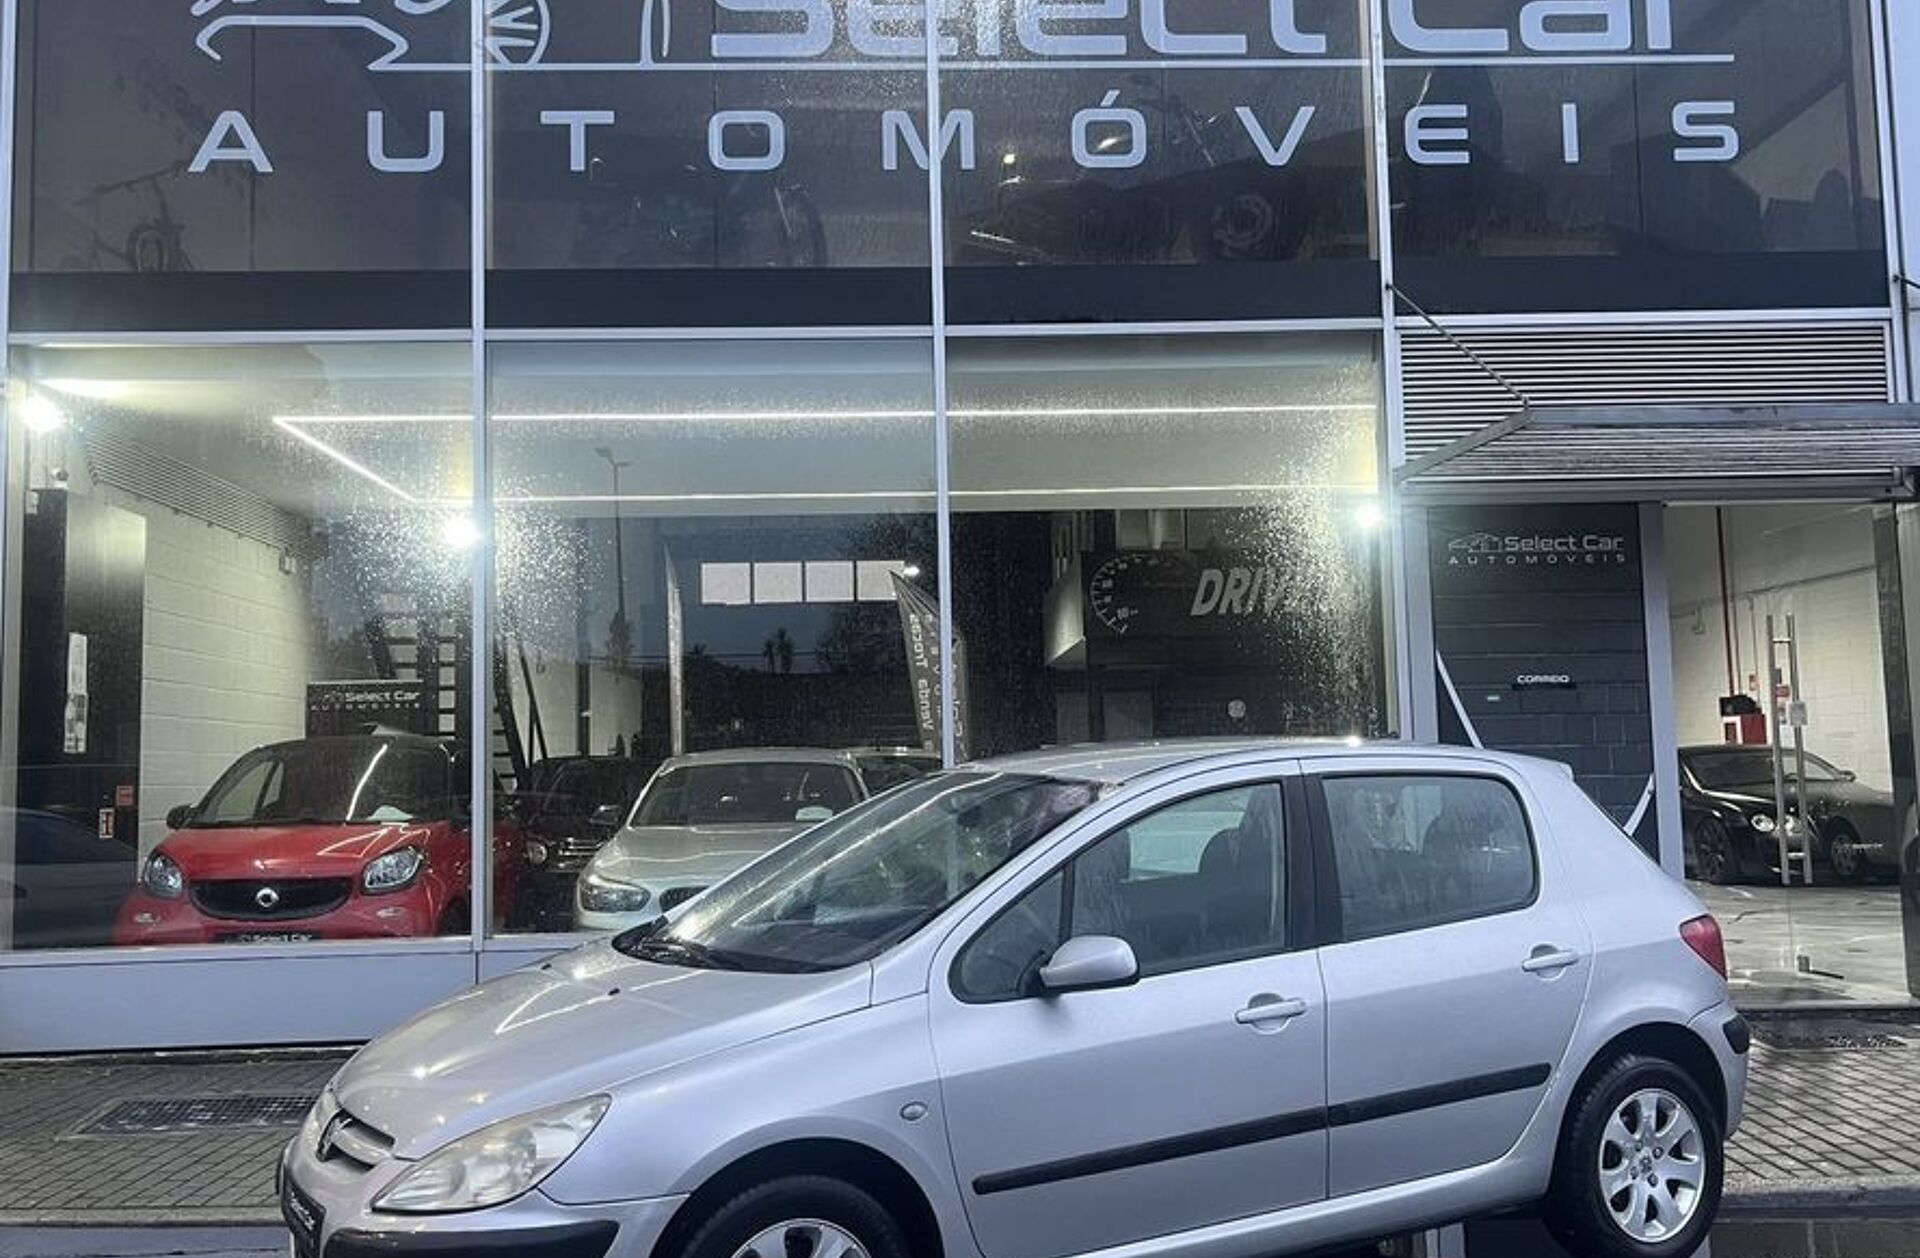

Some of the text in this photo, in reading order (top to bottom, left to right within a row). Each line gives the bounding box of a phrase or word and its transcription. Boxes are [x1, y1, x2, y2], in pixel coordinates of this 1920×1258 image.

[188, 90, 1740, 172] AUTOMÓVEIS
[1504, 534, 1624, 552] Select Car
[393, 689, 420, 701] Car
